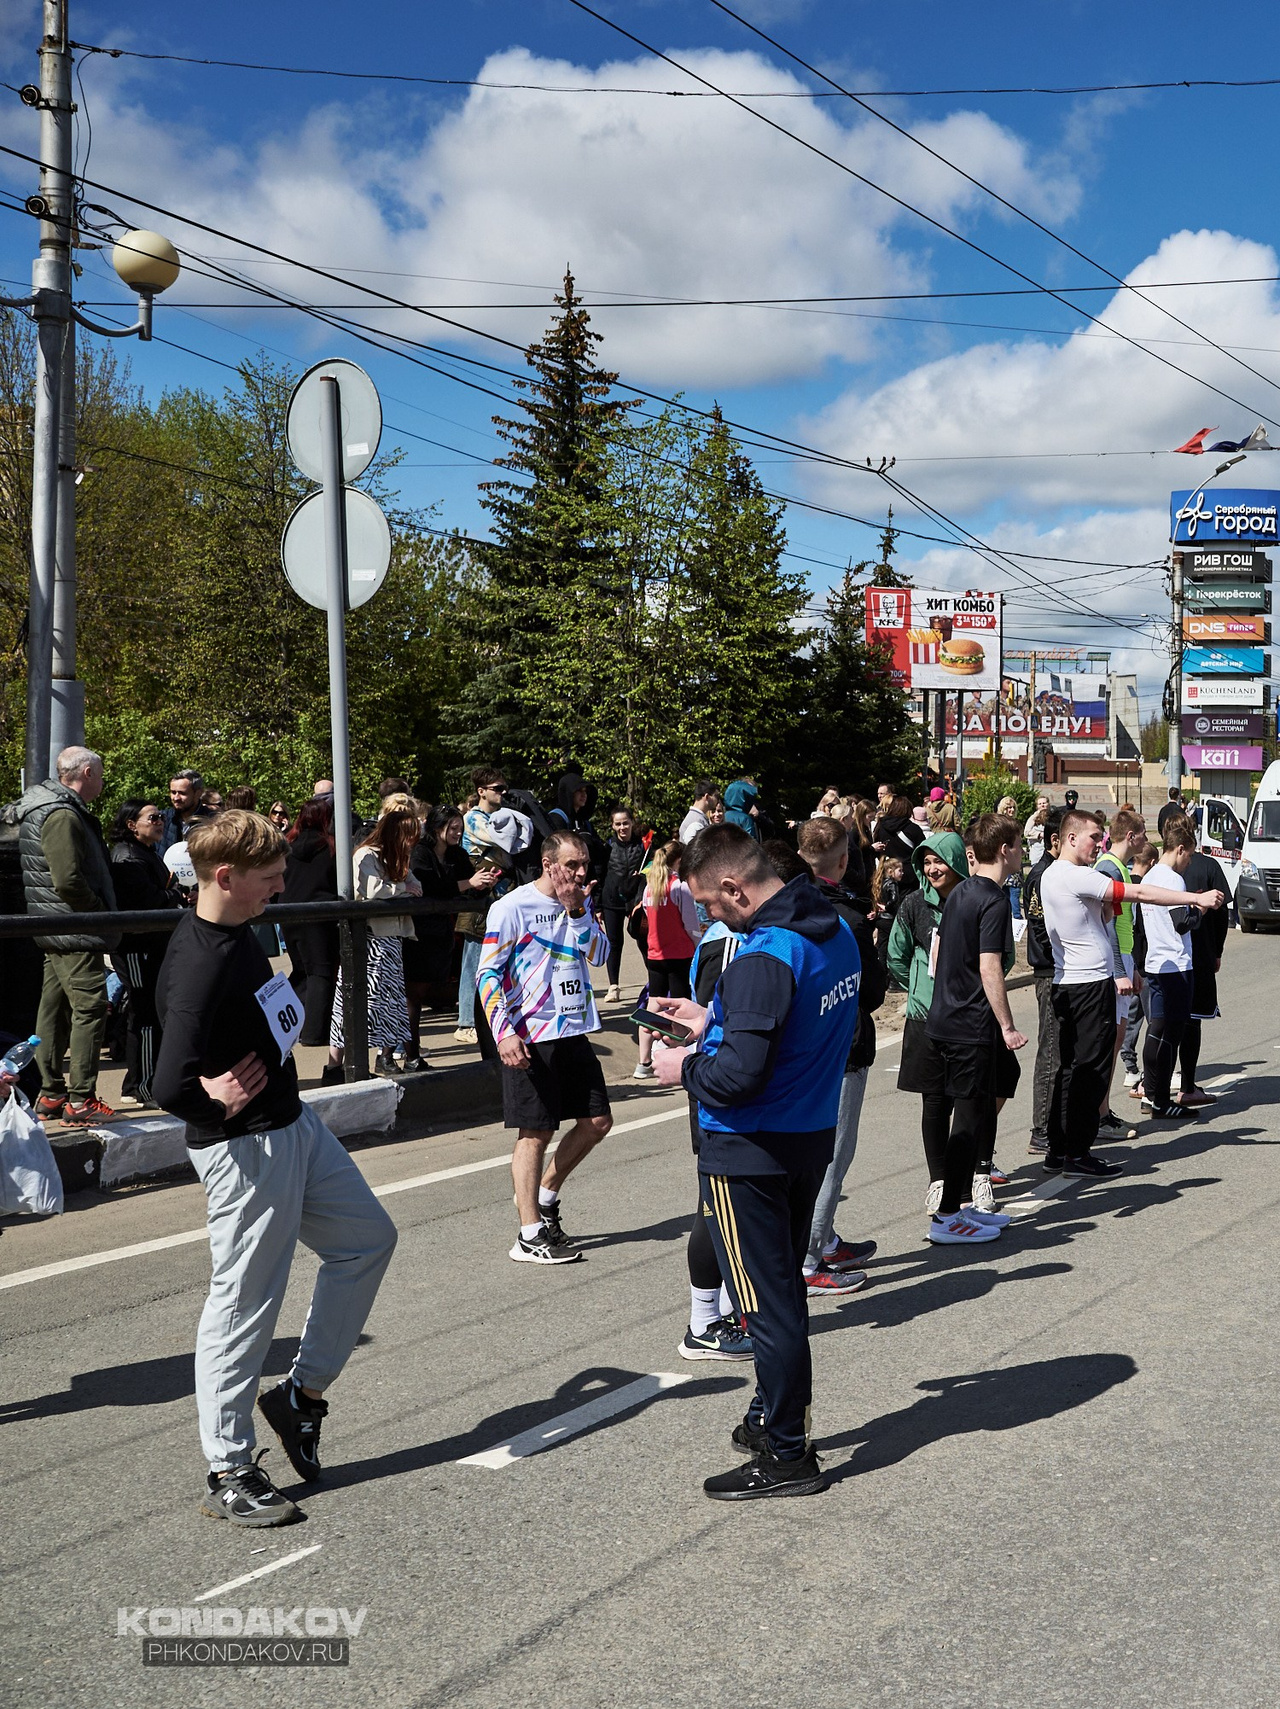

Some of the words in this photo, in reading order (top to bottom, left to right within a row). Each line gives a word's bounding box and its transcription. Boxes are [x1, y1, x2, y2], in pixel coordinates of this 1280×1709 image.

[1215, 504, 1276, 515] Серебряный
[1194, 555, 1220, 566] РИВ
[1223, 554, 1252, 566] ГОШ
[1196, 590, 1261, 600] Перекрёсток
[926, 598, 949, 611] ХИТ
[953, 599, 994, 613] КОМБО
[1189, 622, 1225, 634] DNS
[991, 715, 1091, 736] ПОЕДУ!
[1201, 749, 1239, 766] kari
[559, 979, 582, 996] 152
[278, 1004, 299, 1033] 80
[222, 1489, 239, 1504] N
